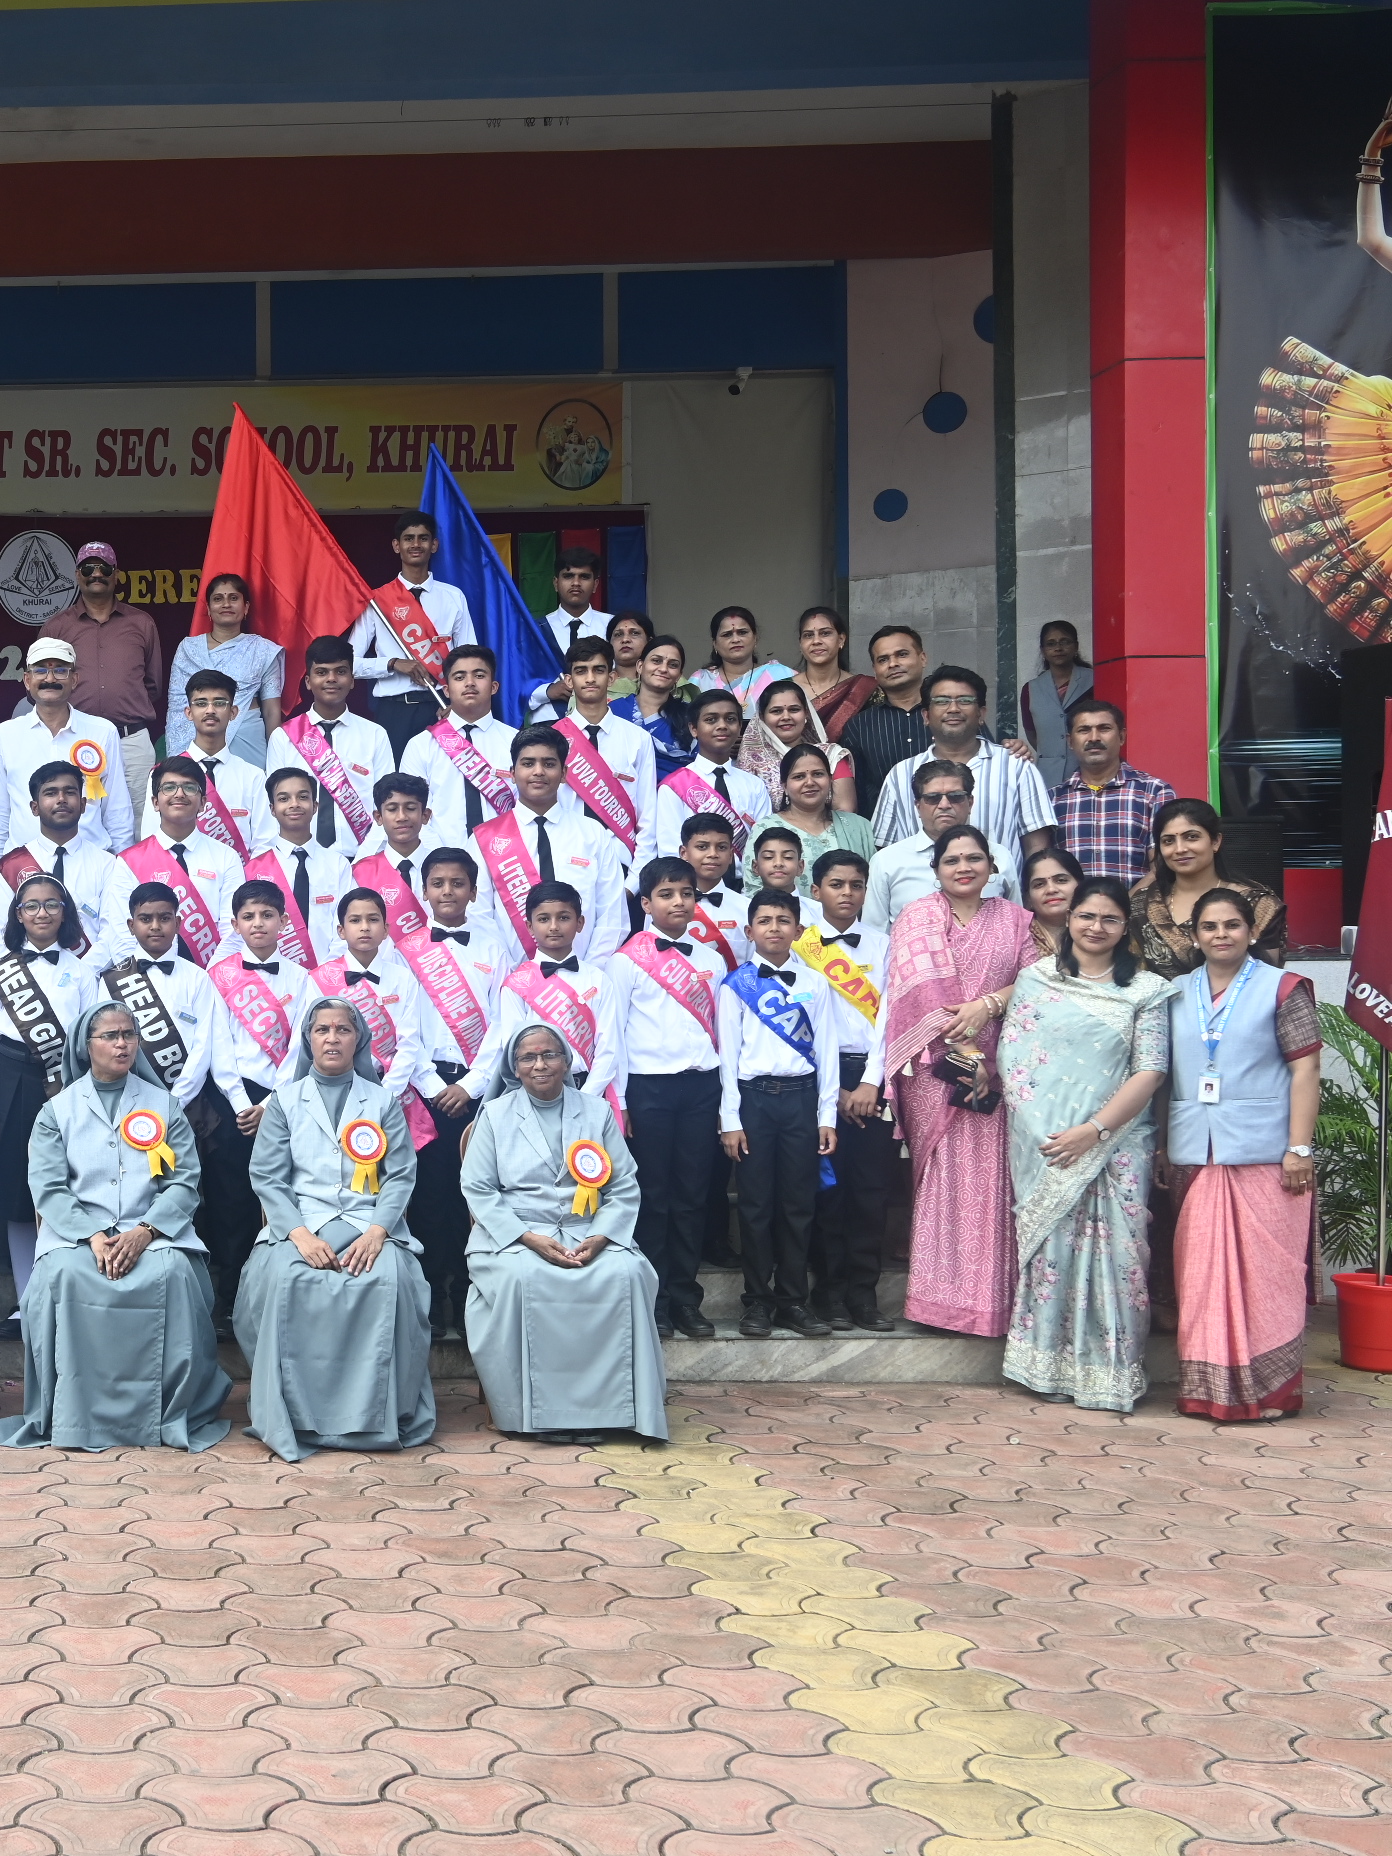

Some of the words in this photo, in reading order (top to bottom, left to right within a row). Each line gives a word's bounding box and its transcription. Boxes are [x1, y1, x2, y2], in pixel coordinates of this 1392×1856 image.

[23, 428, 81, 479] SR.
[95, 426, 178, 478] SEC.
[6, 584, 22, 592] LOVE
[15, 607, 39, 619] DISTRICT
[42, 605, 61, 618] SAGAR
[22, 598, 52, 606] KHURAI
[48, 584, 66, 593] SERVE
[452, 748, 502, 797] HEALTH
[567, 753, 597, 787] YUVA
[590, 779, 631, 829] TOURISM
[172, 885, 218, 966] SECRE
[115, 973, 170, 1043] HEAD
[416, 946, 476, 1019] DISCIPLINE
[1347, 971, 1390, 1020] LOVE
[233, 984, 290, 1060] SECRE
[533, 983, 594, 1051] LITERARY
